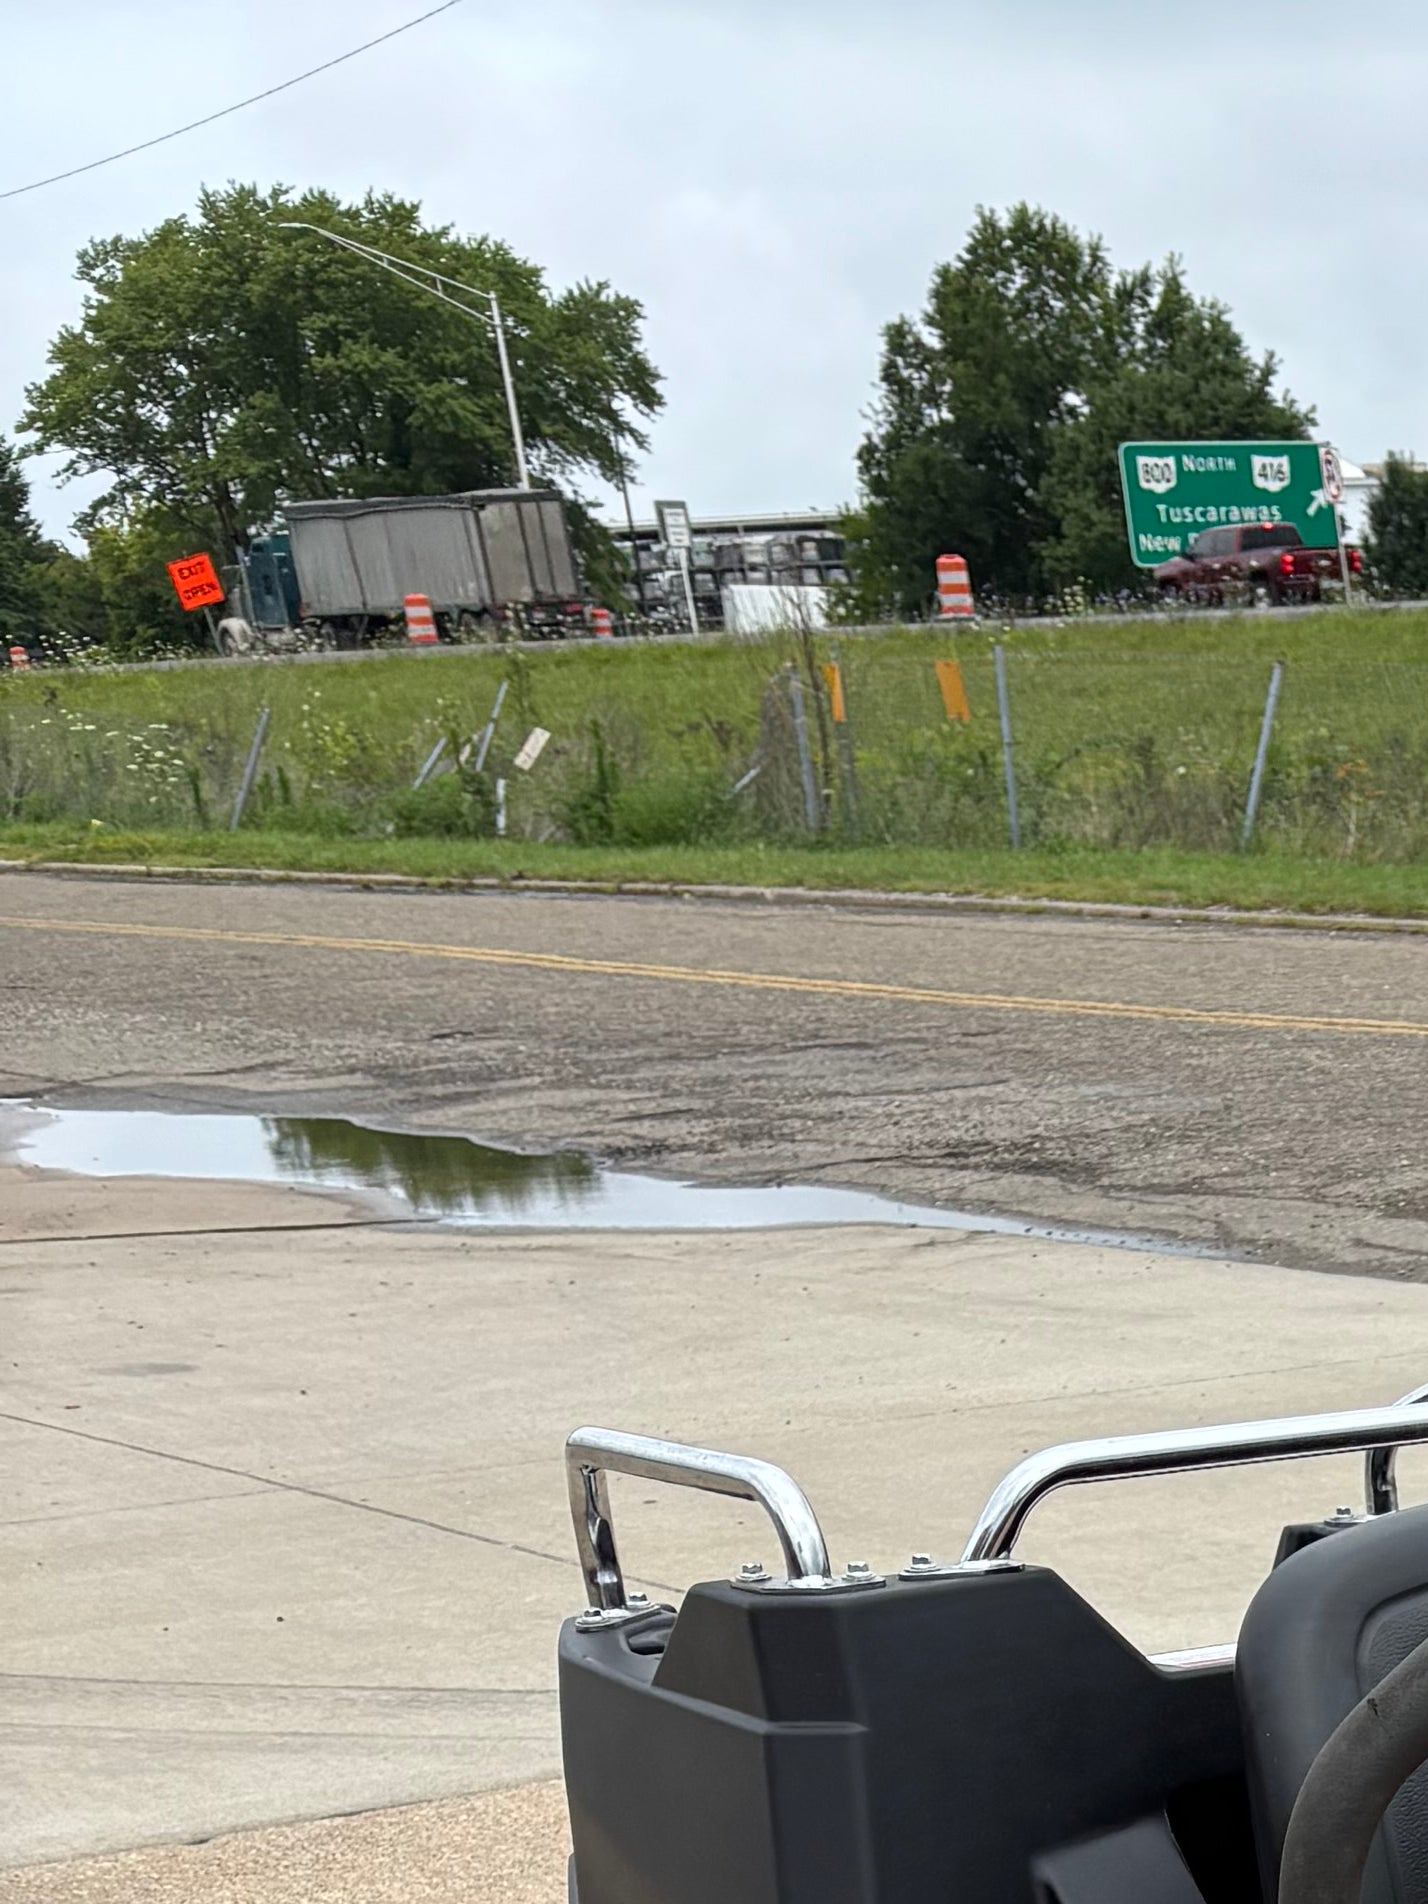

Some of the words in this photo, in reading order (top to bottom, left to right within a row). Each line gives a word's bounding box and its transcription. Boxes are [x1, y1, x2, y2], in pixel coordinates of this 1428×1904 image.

[1141, 462, 1173, 484] 800
[1182, 454, 1237, 472] NORTH
[1257, 462, 1288, 483] 416
[1155, 503, 1283, 523] Tuscarawas
[1138, 533, 1182, 552] New
